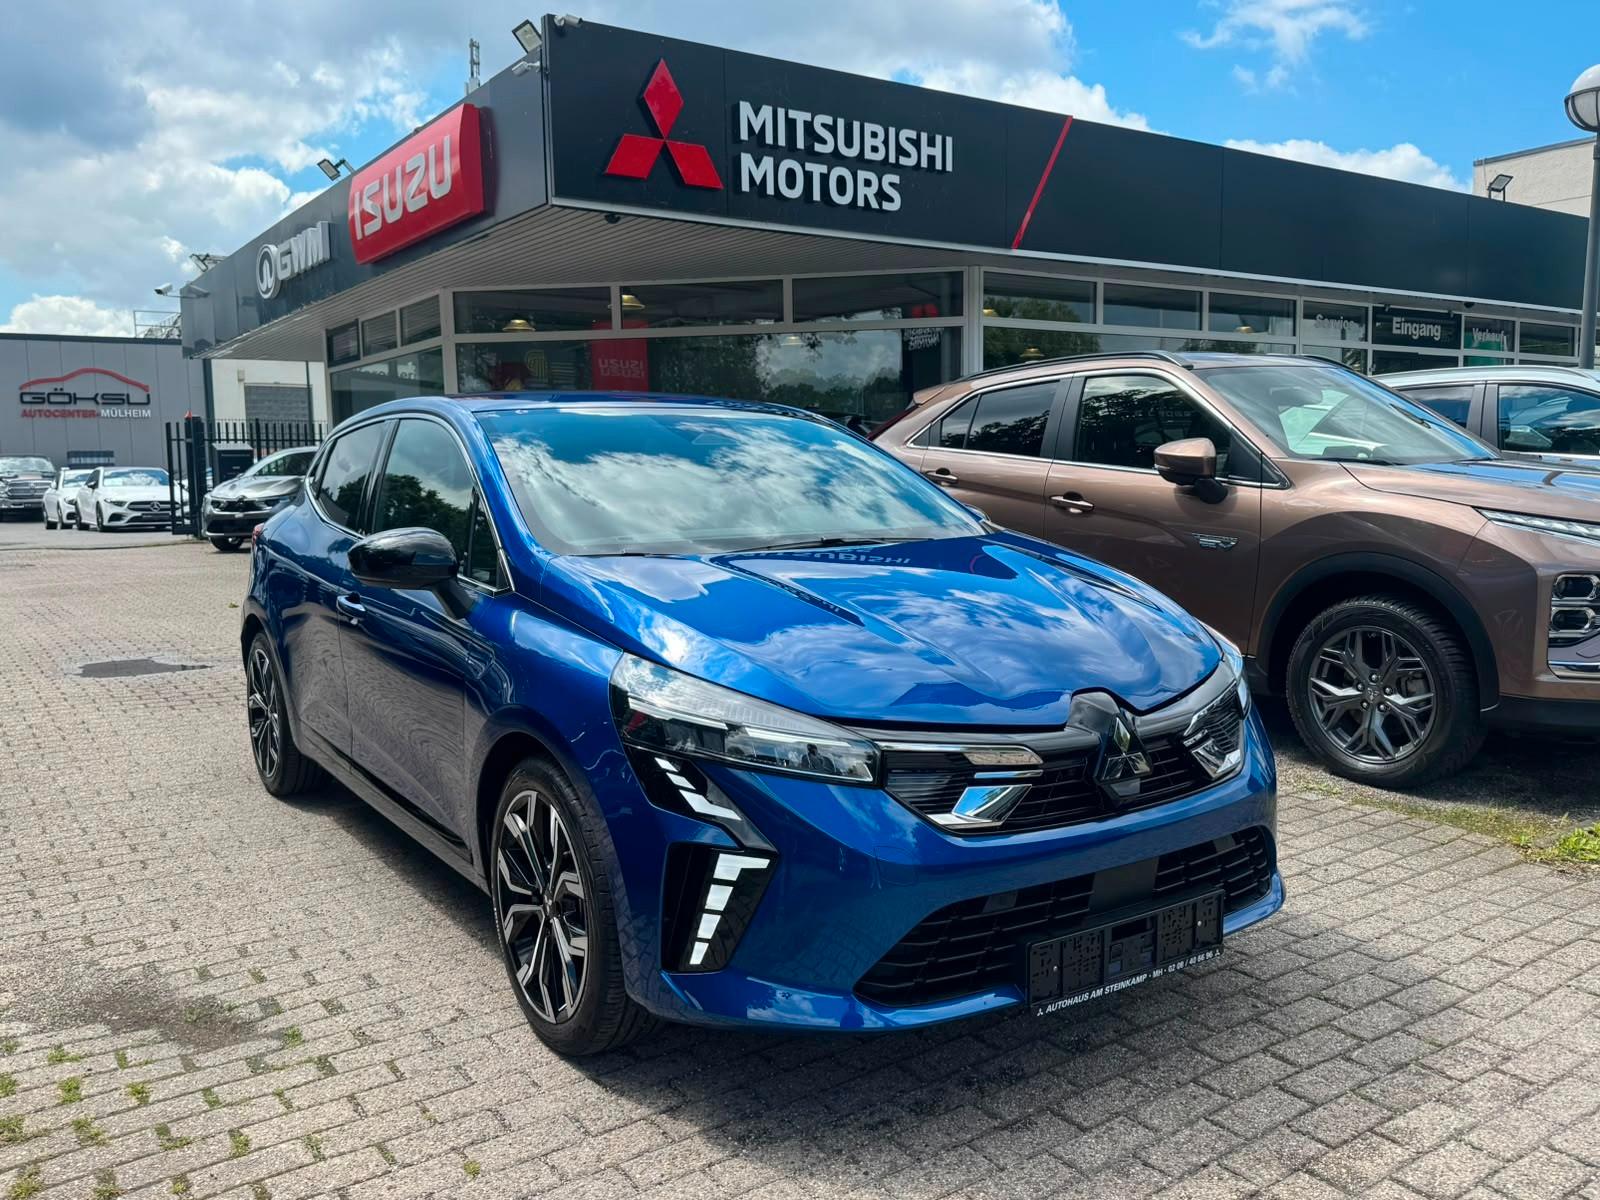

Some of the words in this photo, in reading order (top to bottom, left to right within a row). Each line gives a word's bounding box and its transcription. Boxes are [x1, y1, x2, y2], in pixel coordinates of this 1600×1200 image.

[739, 100, 953, 172] MITSUBISHI
[354, 135, 452, 241] ISUZU
[740, 152, 902, 212] MOTORS
[276, 220, 331, 281] GWM
[1392, 317, 1442, 341] Eingang
[19, 387, 151, 405] GÖKSU
[1045, 992, 1090, 1013] AUTOHAUS
[1089, 986, 1104, 999] AM
[1104, 974, 1147, 994] STEINKAMP
[1152, 968, 1163, 978] MH
